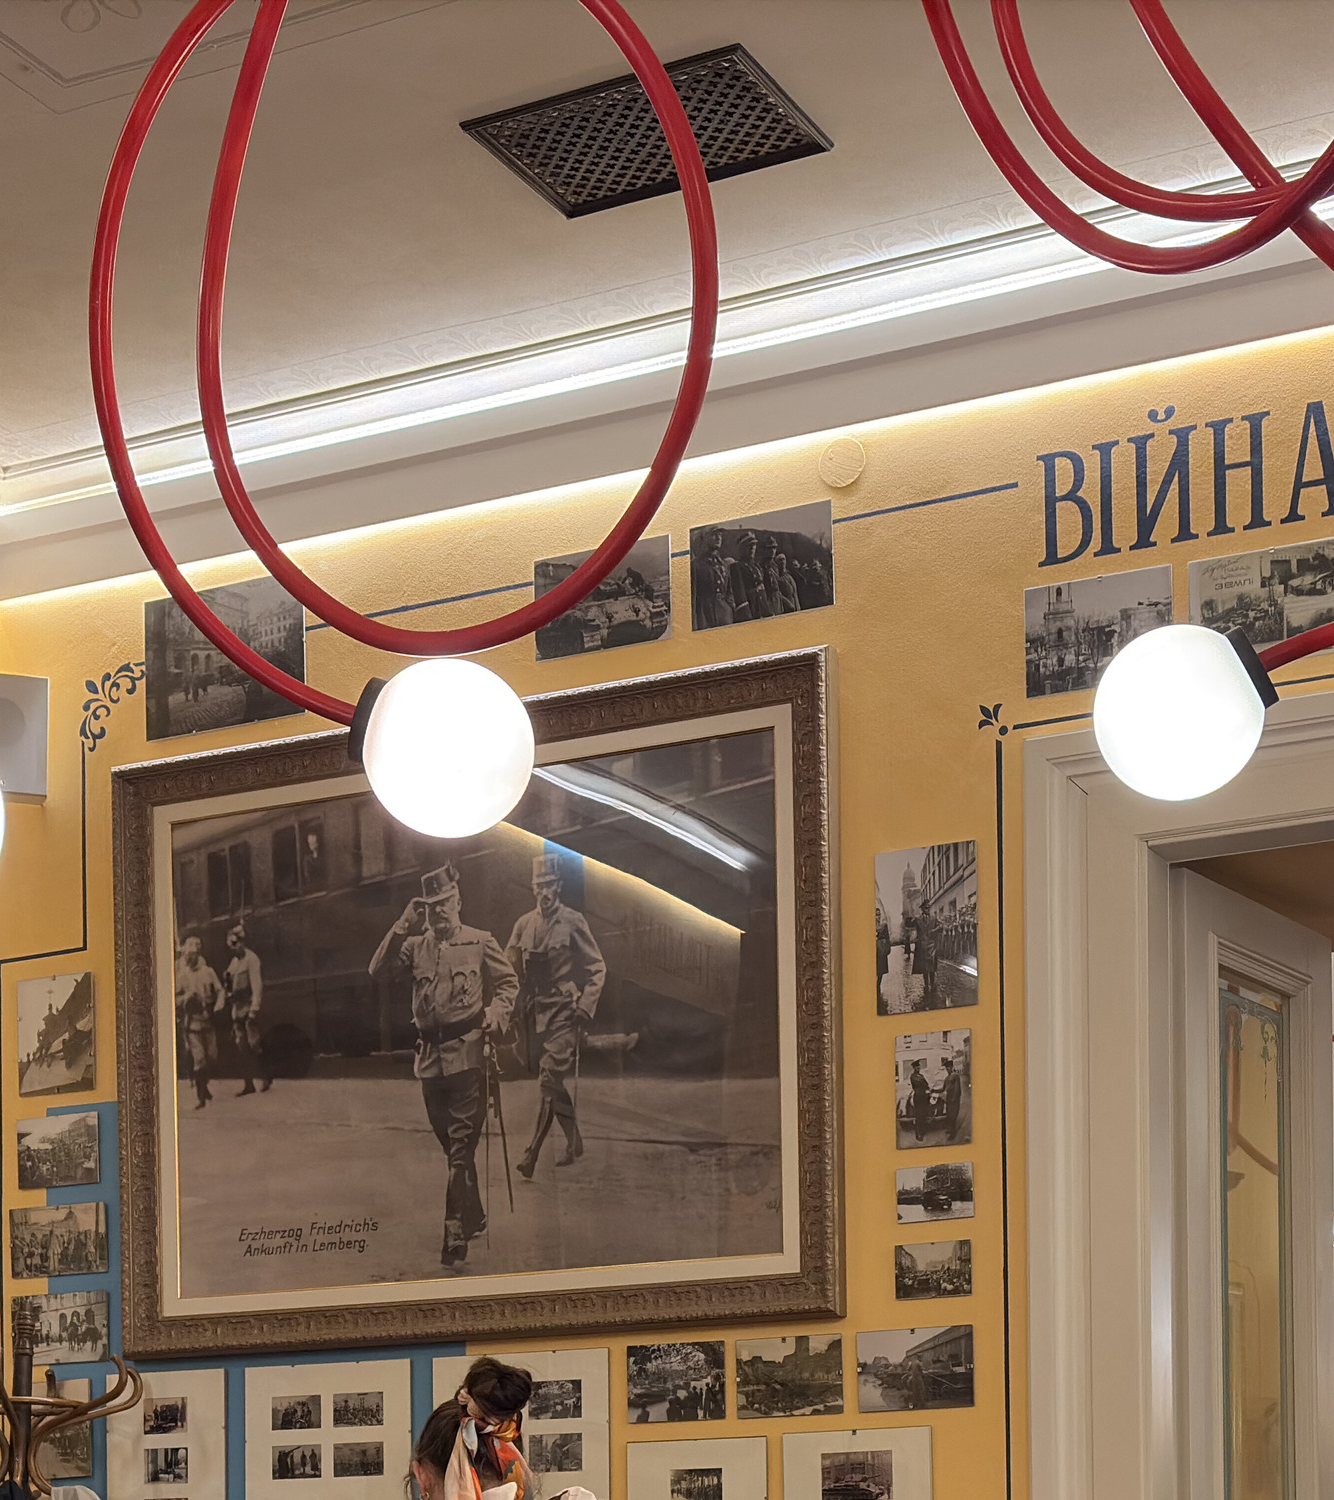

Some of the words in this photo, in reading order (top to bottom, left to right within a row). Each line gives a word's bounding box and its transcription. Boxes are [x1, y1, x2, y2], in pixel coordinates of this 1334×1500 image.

[238, 1226, 303, 1241] Erzherzog
[310, 1217, 379, 1237] Friedrich's
[243, 1240, 294, 1257] Ankunft
[295, 1240, 308, 1253] in
